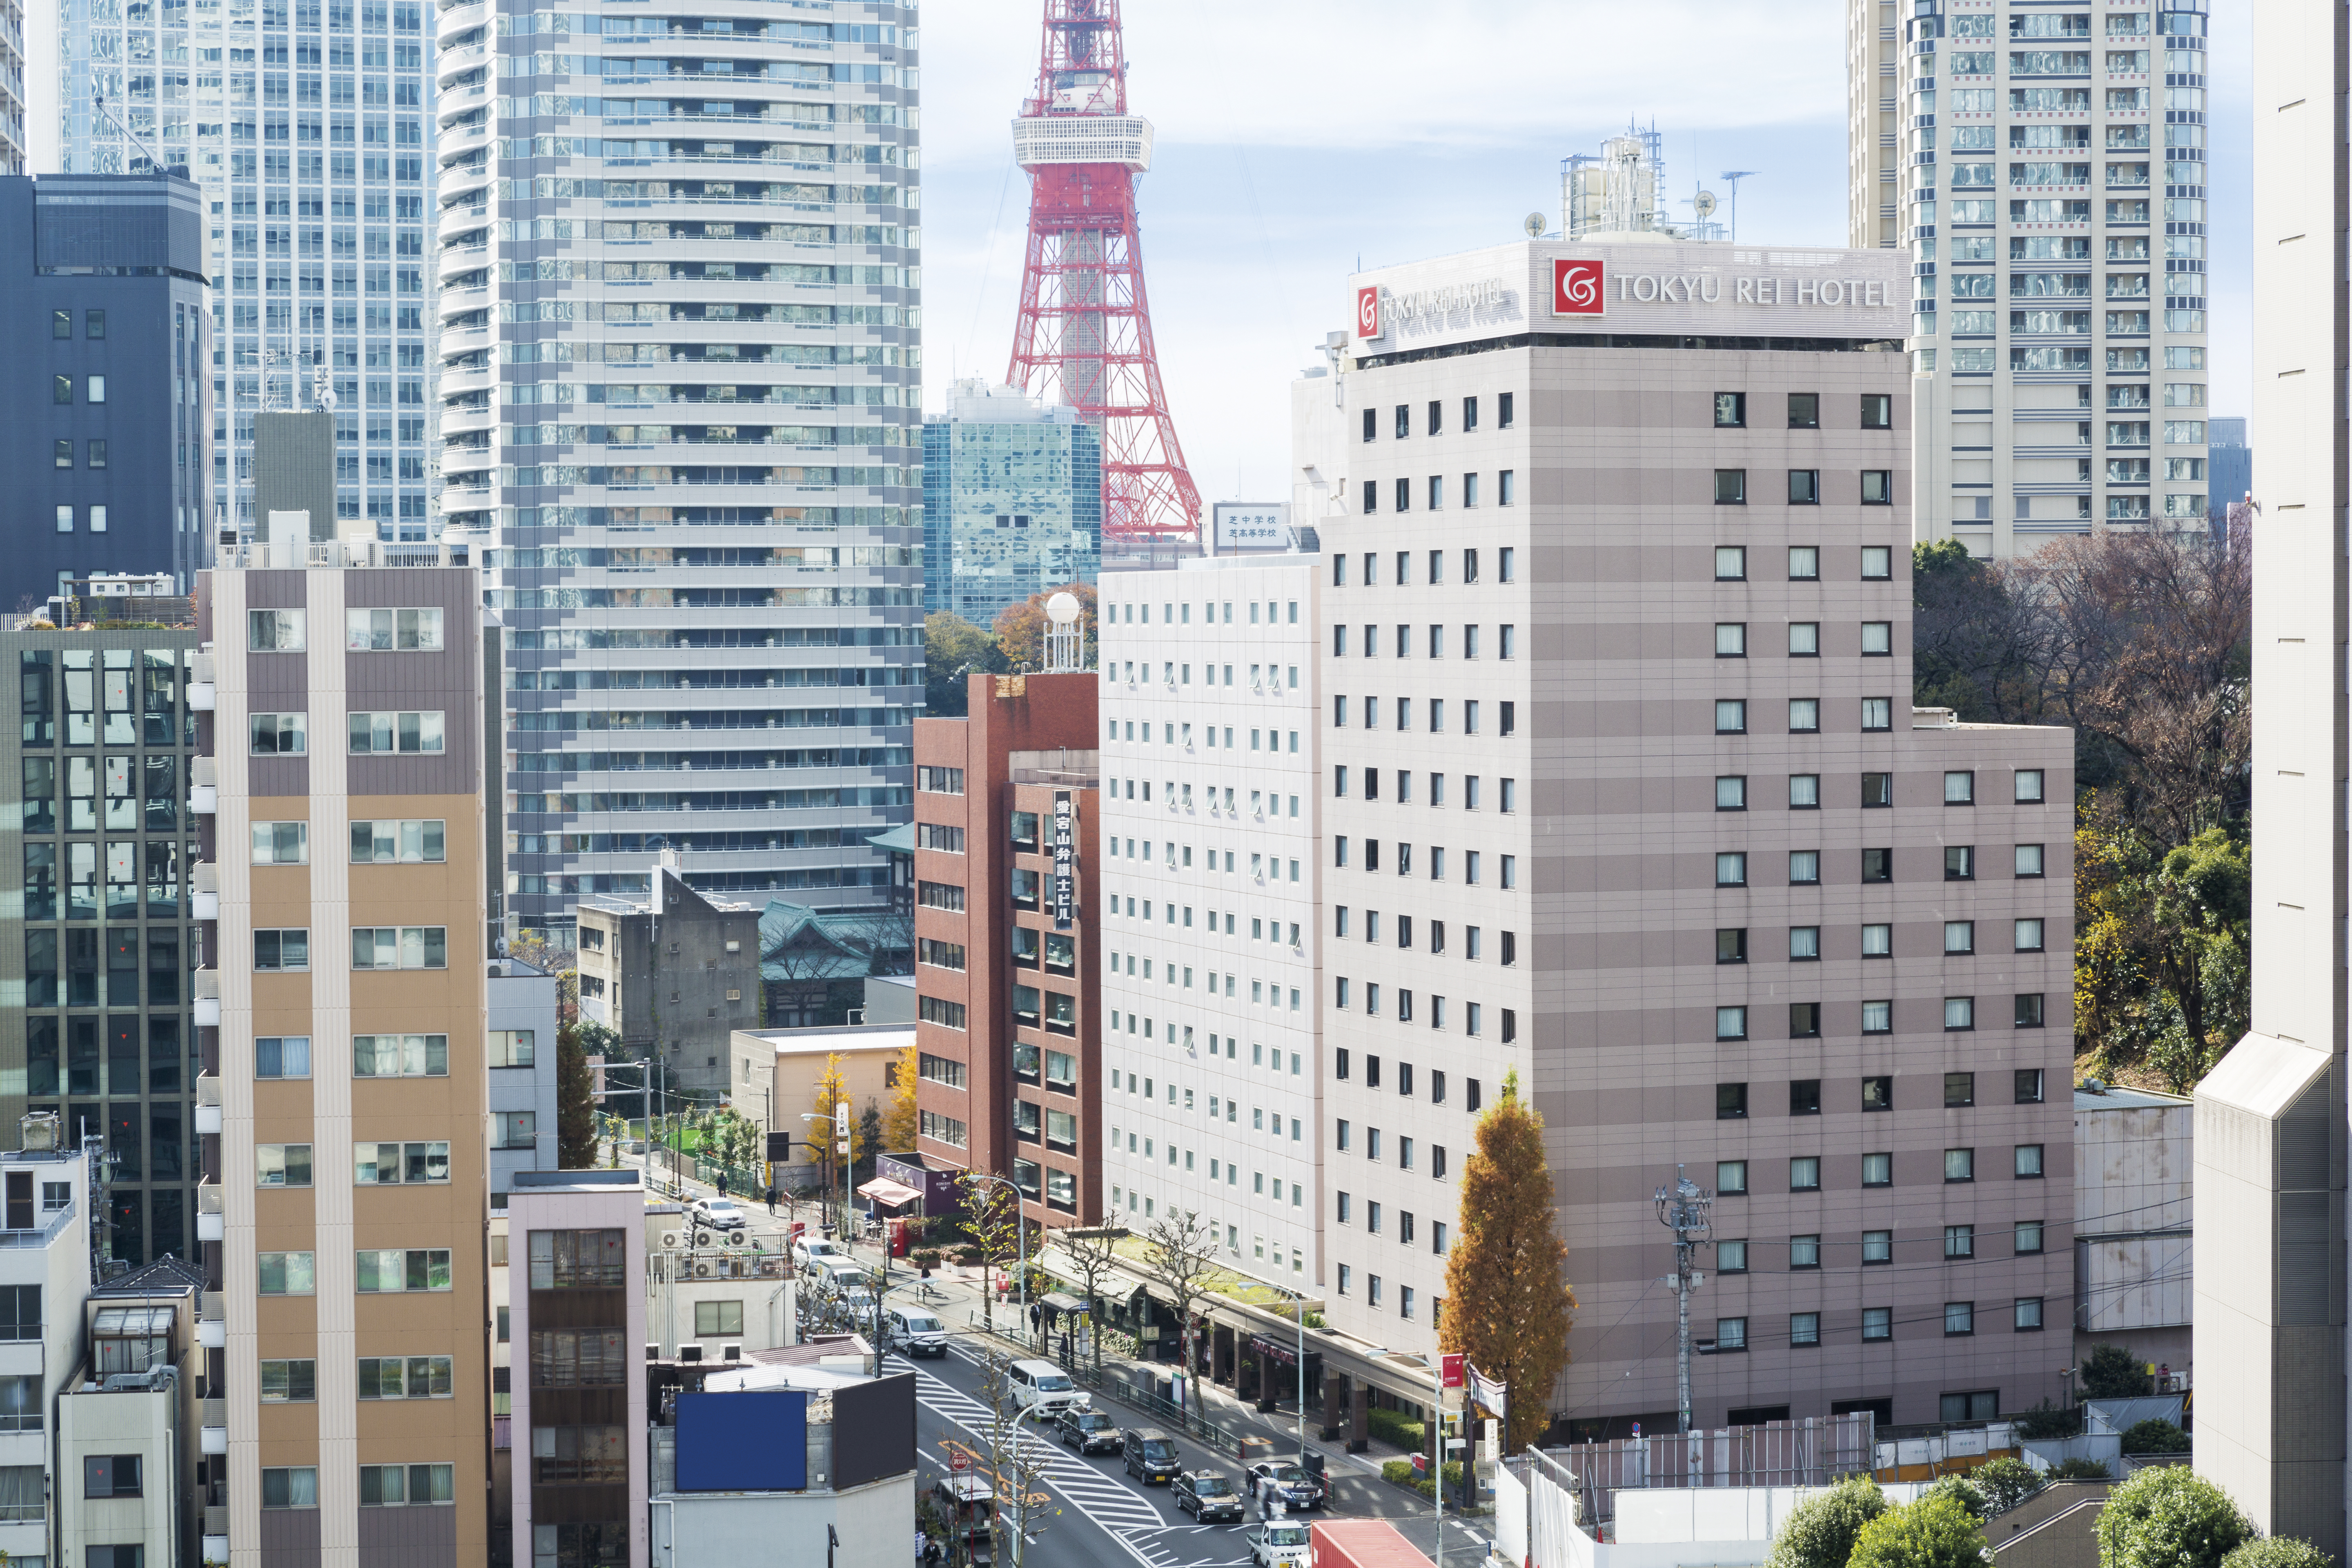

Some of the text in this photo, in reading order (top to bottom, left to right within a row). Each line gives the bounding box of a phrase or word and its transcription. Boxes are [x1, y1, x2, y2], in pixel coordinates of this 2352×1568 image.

[1381, 277, 1506, 322] TOKYU REI HOTEL
[1613, 273, 1897, 307] TOKYU REI HOTEL
[1229, 515, 1276, 525] 芝中学校
[1229, 528, 1276, 538] 芝高等学校
[1056, 800, 1071, 920] 愛宕山弁護士ビル
[1252, 1338, 1269, 1354] TOKYU
[1278, 1349, 1295, 1365] HOTEL
